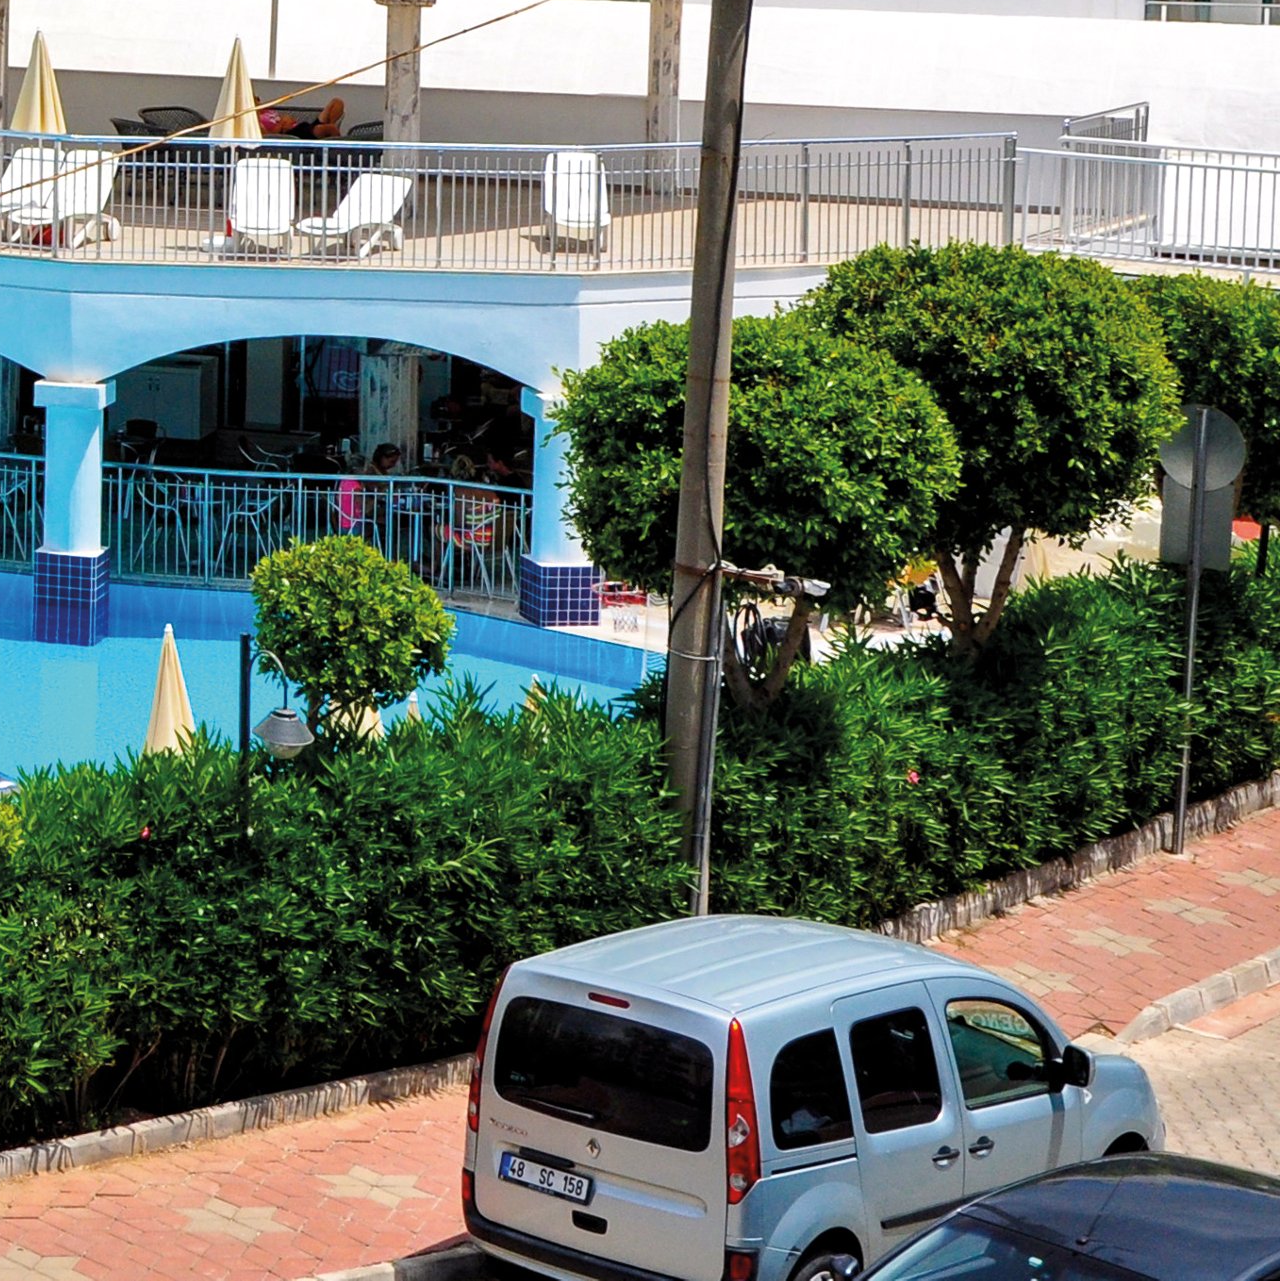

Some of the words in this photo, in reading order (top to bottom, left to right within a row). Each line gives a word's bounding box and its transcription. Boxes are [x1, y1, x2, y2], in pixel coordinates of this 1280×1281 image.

[510, 1159, 526, 1179] 48
[539, 1168, 555, 1187] SC
[563, 1176, 584, 1197] 158
